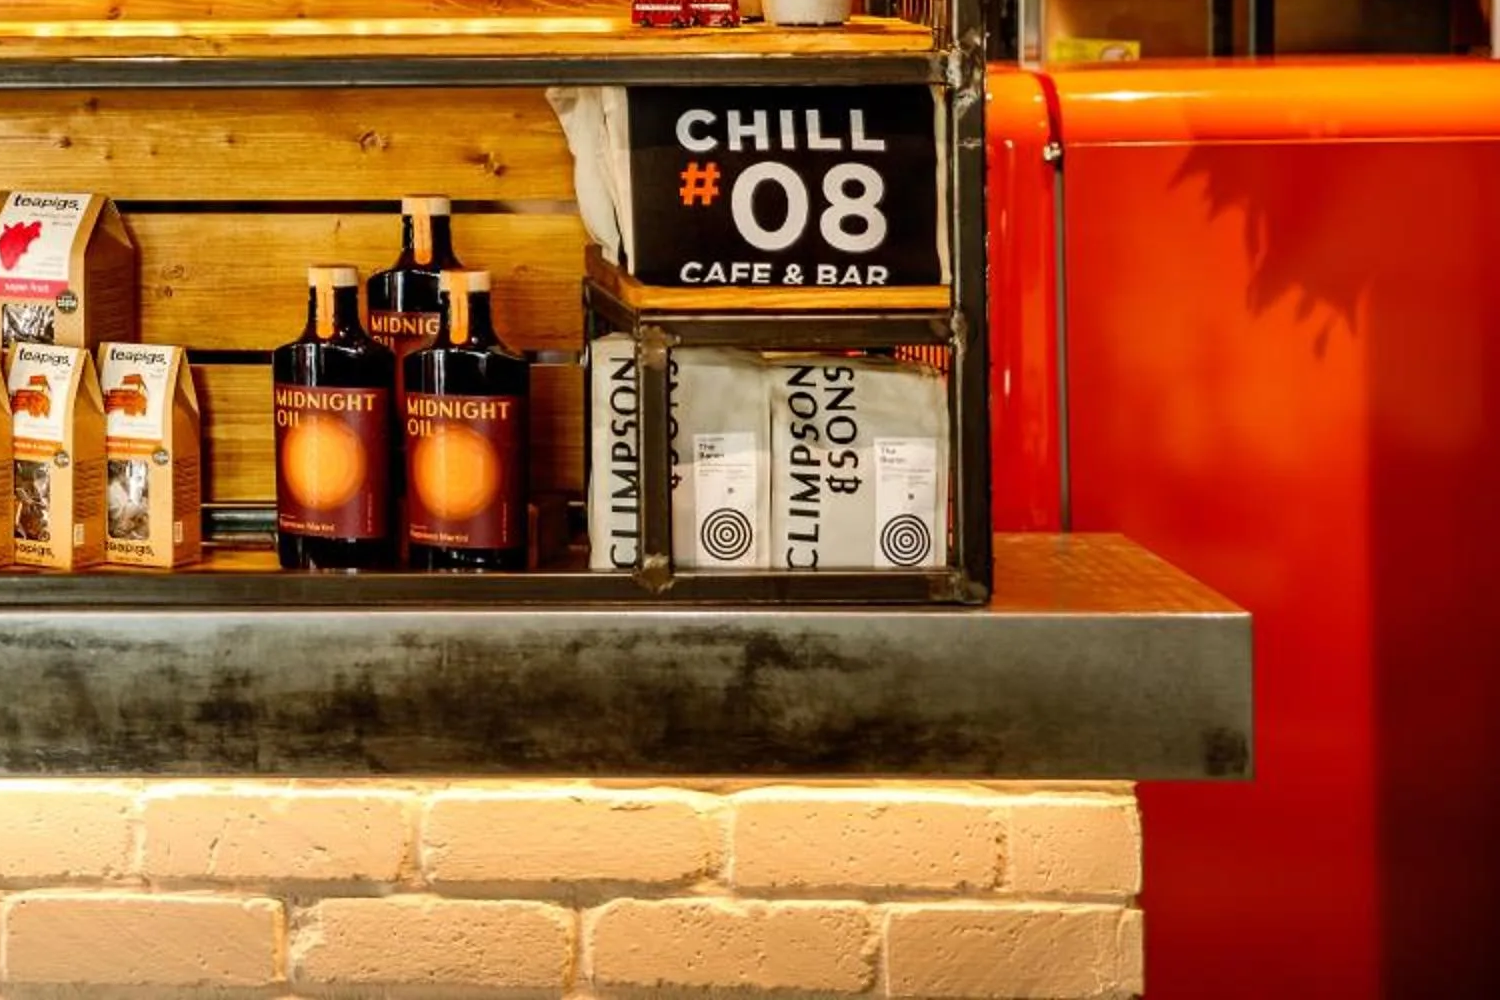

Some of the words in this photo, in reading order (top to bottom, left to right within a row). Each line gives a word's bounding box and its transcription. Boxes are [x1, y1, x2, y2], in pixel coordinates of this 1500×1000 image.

[674, 107, 887, 153] CHILL
[678, 159, 889, 253] #08
[679, 260, 773, 285] CAFE
[781, 262, 805, 286] &
[815, 263, 891, 286] BAR
[371, 314, 440, 336] MIDNIG
[276, 388, 377, 412] MIDNIGHT
[406, 396, 511, 420] MIDNIGHT
[277, 409, 301, 429] OIL
[406, 418, 434, 438] OIL
[609, 356, 641, 570] CLIMPSON
[786, 364, 822, 571] CLIMPSON
